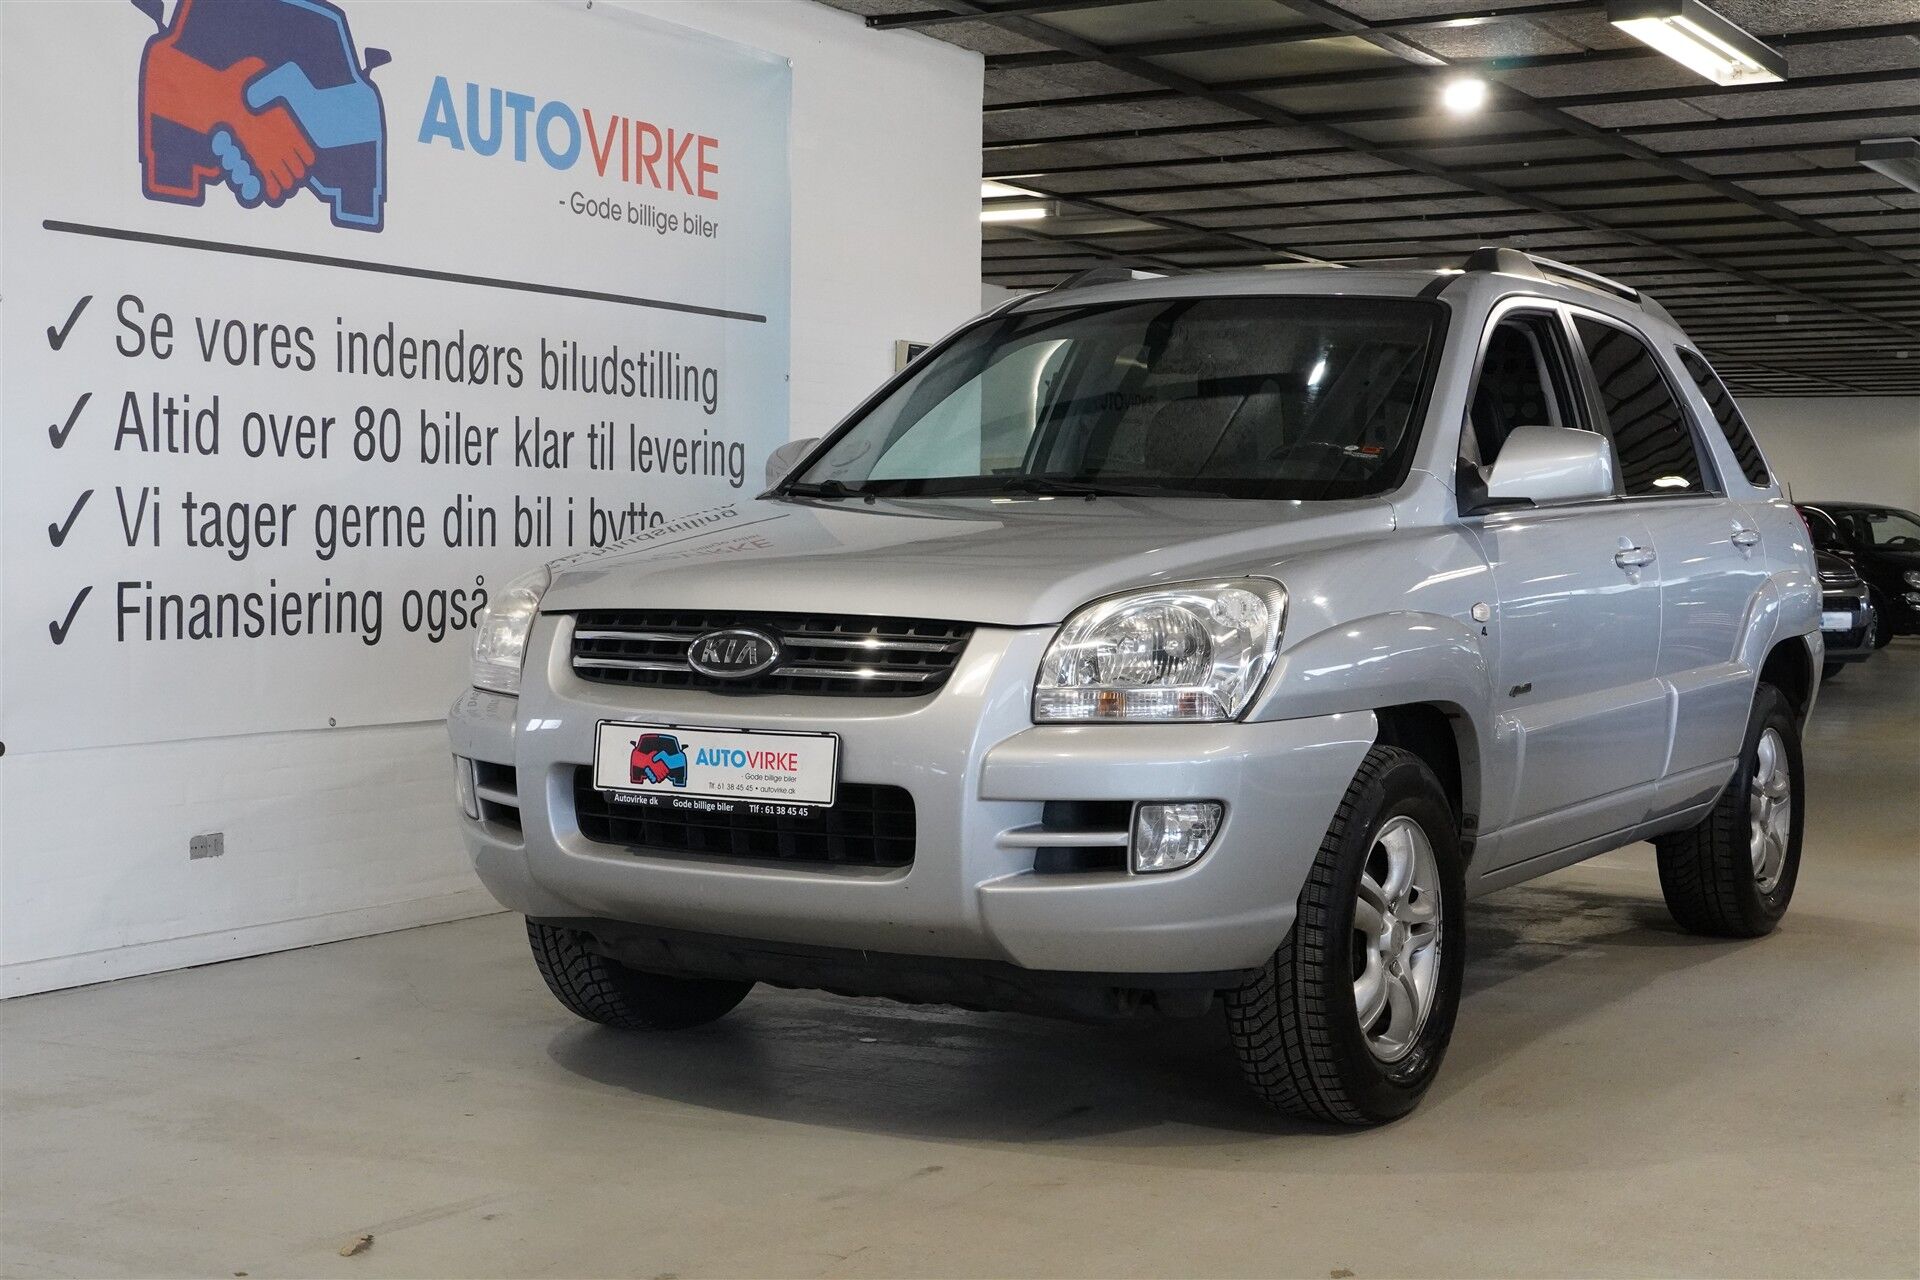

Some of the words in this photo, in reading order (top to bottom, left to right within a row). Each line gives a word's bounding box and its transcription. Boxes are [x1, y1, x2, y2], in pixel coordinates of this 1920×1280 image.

[419, 76, 719, 200] AUTOVIRKE
[570, 191, 622, 221] Gode
[628, 201, 678, 235] billige
[683, 212, 719, 239] biler
[116, 295, 173, 360] Se
[196, 317, 316, 372] vores
[336, 316, 524, 390] indendørs
[541, 337, 719, 415] biludstilling
[115, 391, 219, 456] Altid
[243, 412, 336, 459] over
[353, 405, 401, 463] 80
[420, 409, 499, 468] biler
[515, 415, 575, 470] klar
[587, 420, 614, 471] til
[630, 423, 746, 489] levering
[116, 486, 160, 547] Vi
[182, 491, 297, 562] tager
[315, 503, 425, 561] gerne
[443, 493, 496, 549] din
[514, 494, 552, 548] bil
[568, 496, 573, 547] i
[117, 577, 383, 647] Finansiering
[701, 637, 758, 665] KIA
[695, 747, 798, 772] AUTOVIRKE
[745, 772, 763, 781] Gode
[764, 774, 782, 783] billige
[783, 775, 797, 783] biler
[614, 793, 648, 804] Autovirke
[649, 797, 659, 806] dk
[672, 798, 692, 810] Gode
[693, 800, 715, 812] billige
[717, 803, 734, 812] biler
[749, 804, 759, 814] Tlf
[765, 805, 775, 815] 61
[776, 806, 786, 816] 38
[787, 807, 797, 817] 45
[798, 807, 809, 818] 45
[716, 782, 725, 790] 61
[726, 783, 735, 791] 38
[735, 783, 744, 792] 45
[745, 784, 754, 792] 45
